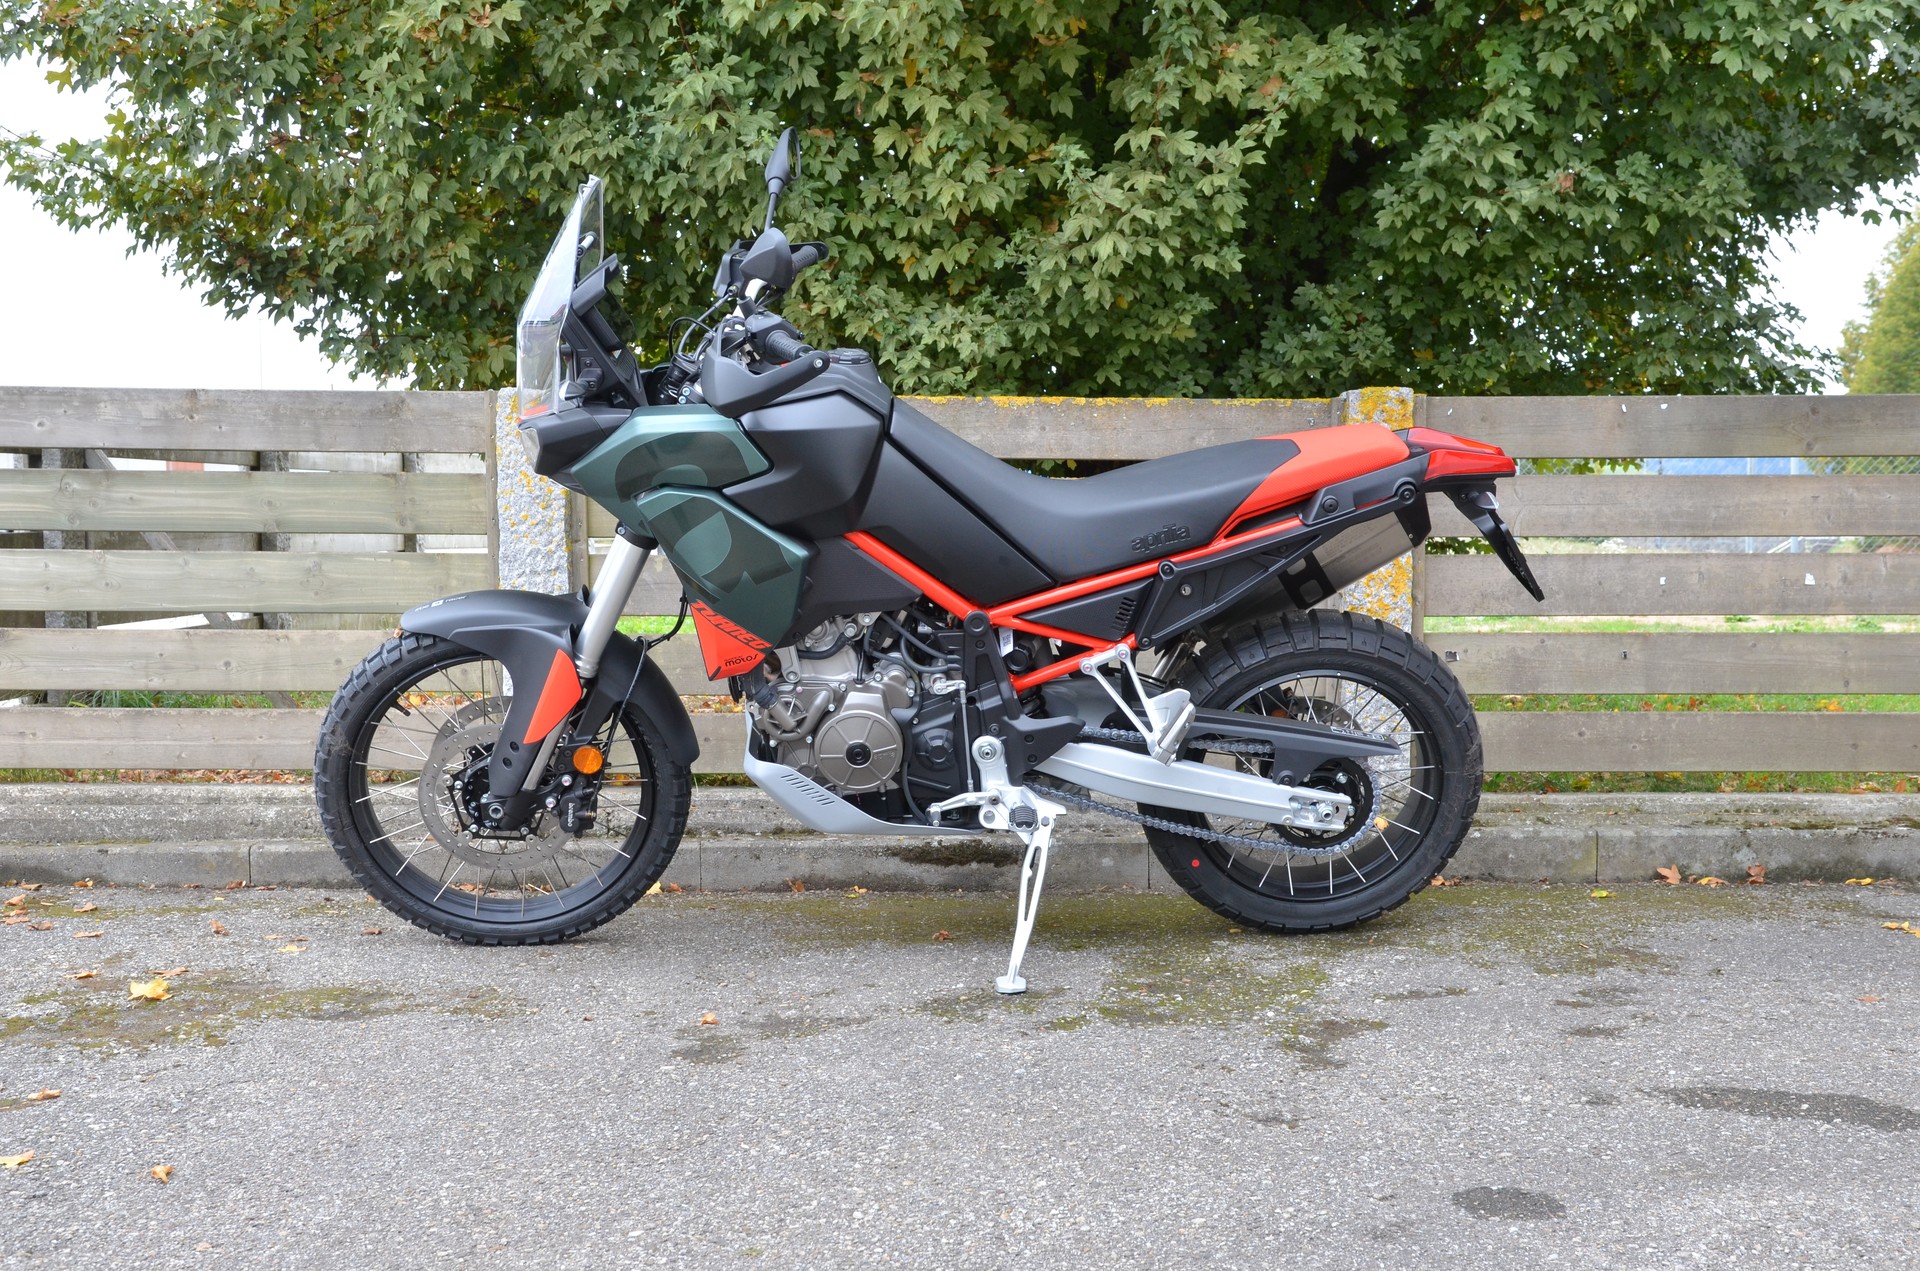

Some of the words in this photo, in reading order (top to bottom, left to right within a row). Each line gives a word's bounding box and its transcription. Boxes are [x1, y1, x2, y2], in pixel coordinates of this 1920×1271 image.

[1131, 523, 1191, 553] aprilia
[691, 599, 774, 650] TUAREG
[724, 653, 759, 667] motos
[567, 802, 576, 827] brembo
